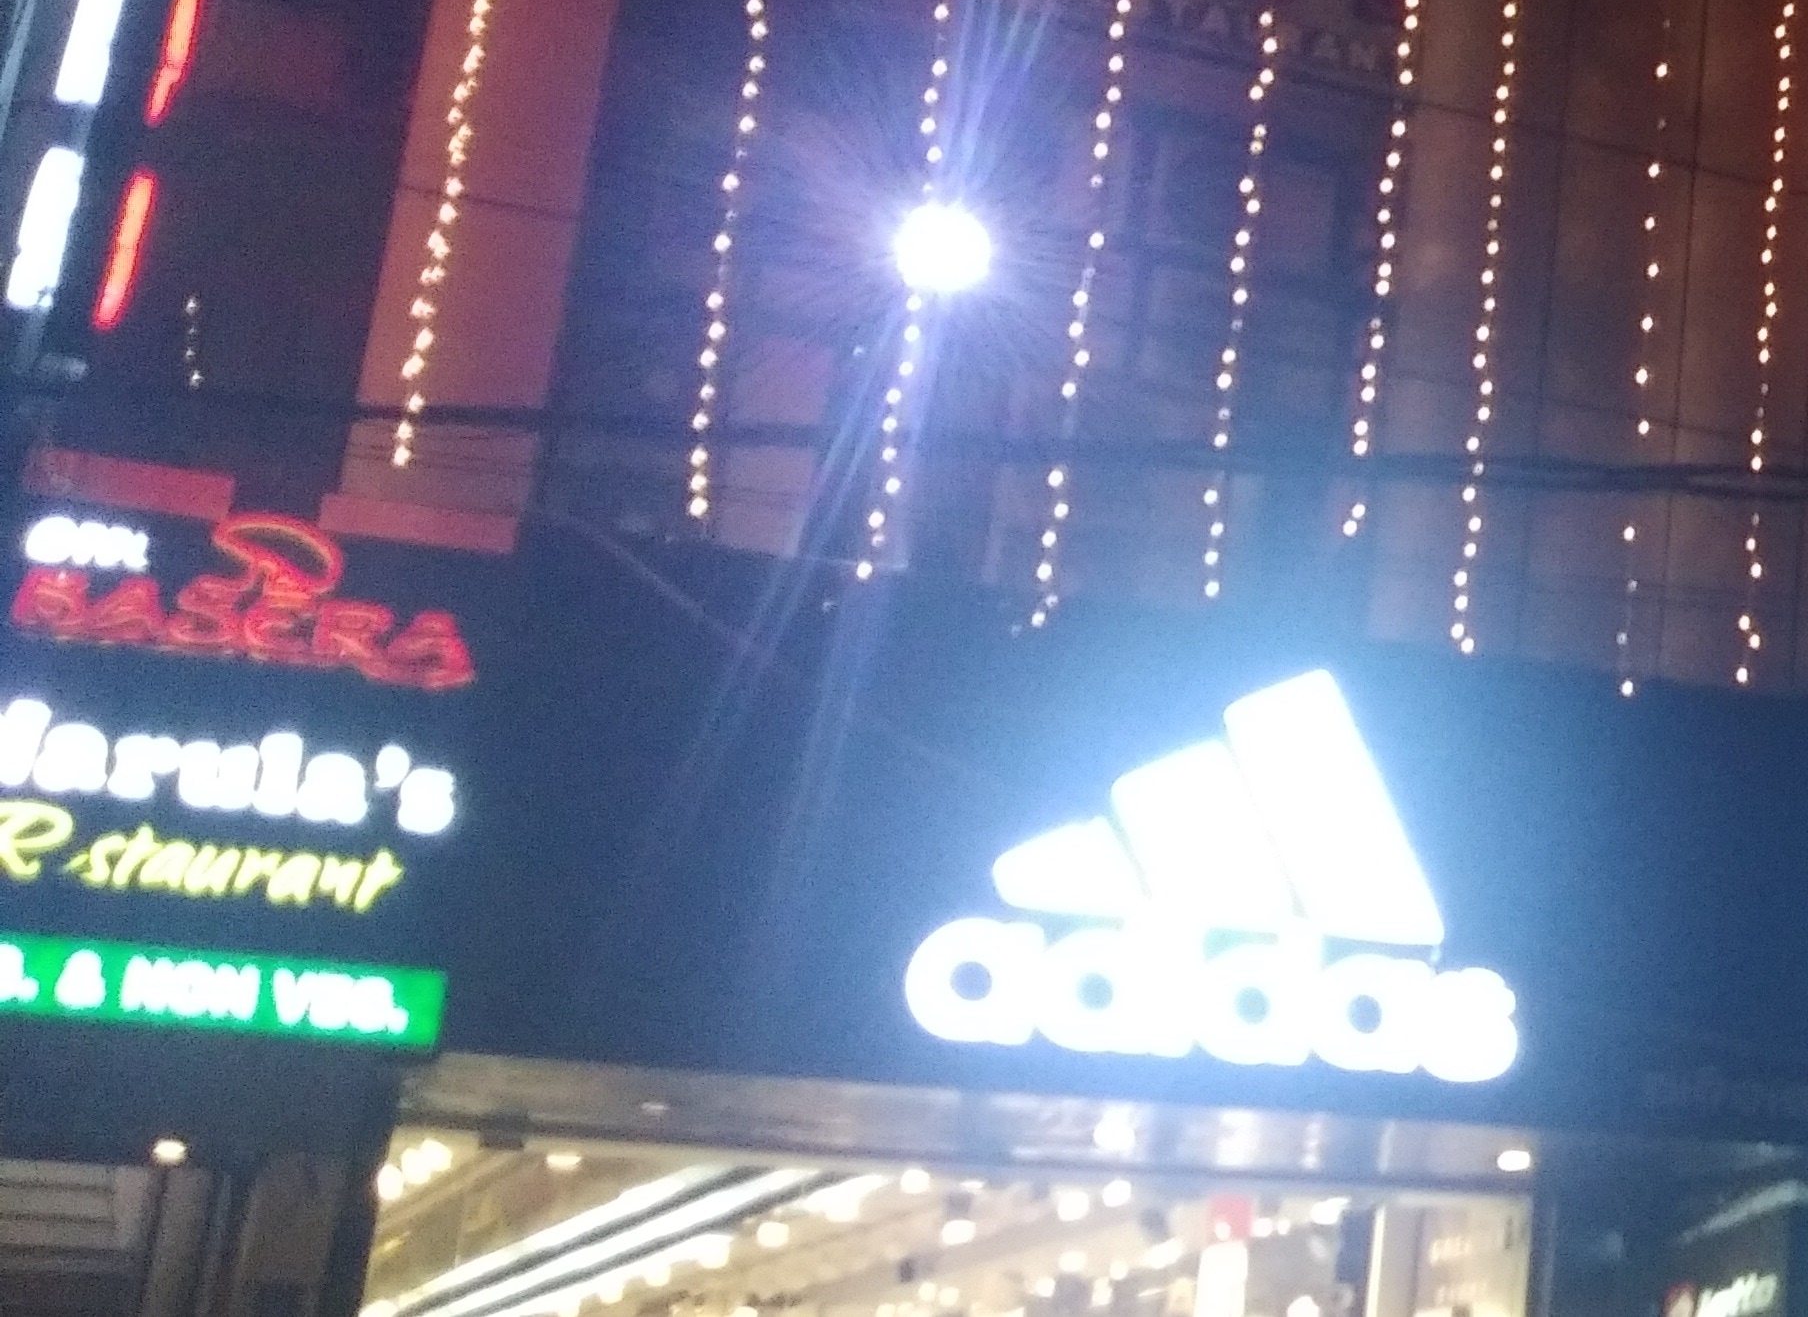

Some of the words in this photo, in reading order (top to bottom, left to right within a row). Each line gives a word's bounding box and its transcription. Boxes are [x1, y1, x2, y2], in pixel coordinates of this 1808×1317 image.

[11, 566, 476, 690] BASERA
[120, 953, 260, 1021] NON
[905, 907, 1519, 1083] adidas
